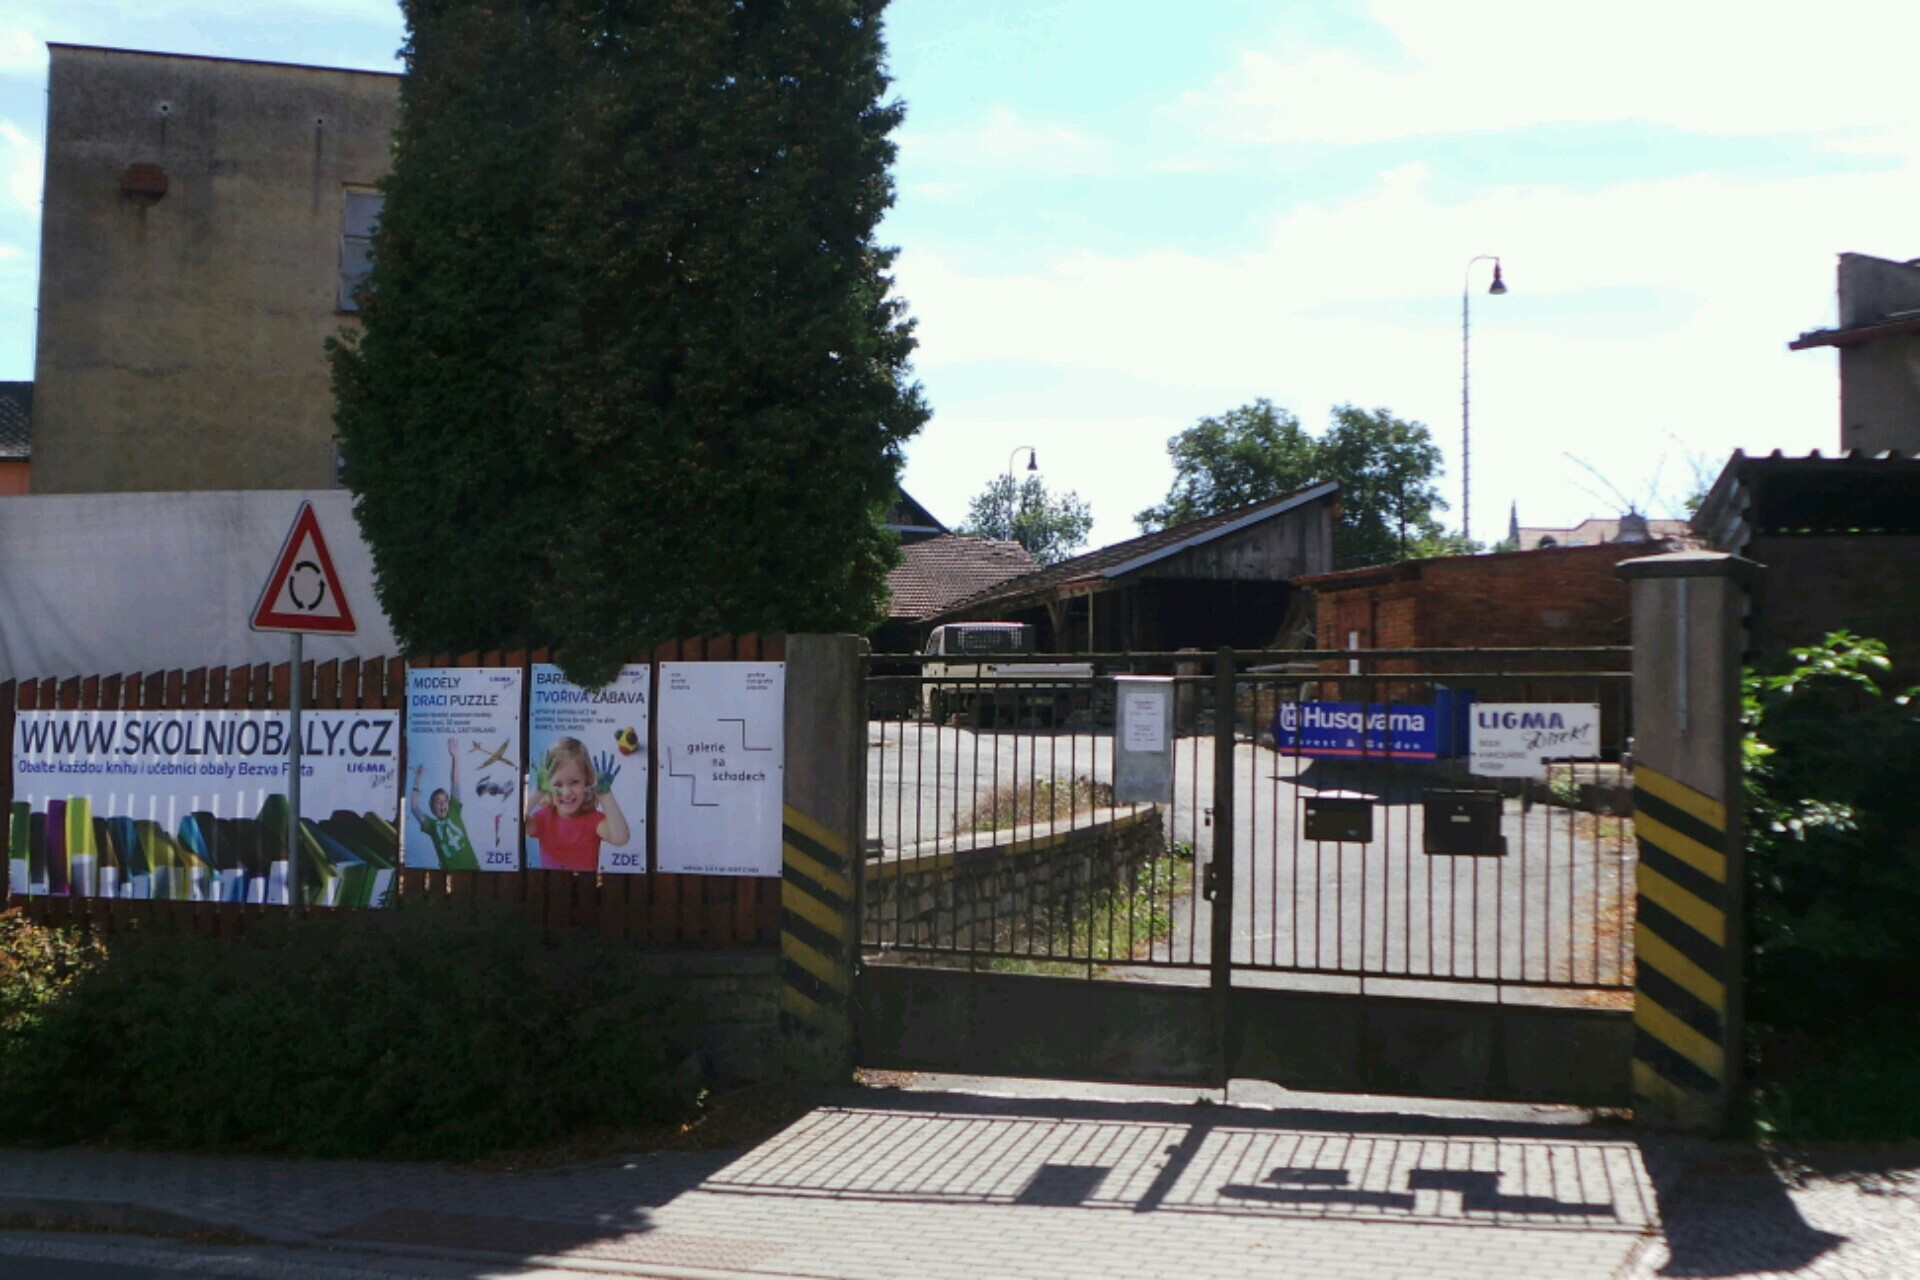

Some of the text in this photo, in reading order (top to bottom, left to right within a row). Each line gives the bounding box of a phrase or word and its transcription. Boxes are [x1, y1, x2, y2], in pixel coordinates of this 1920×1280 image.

[413, 676, 461, 689] MODELY
[412, 694, 499, 707] DRACI PUZZLE
[1304, 706, 1425, 733] Husqvarna
[1478, 711, 1565, 730] LIGMA
[20, 719, 394, 757] WWW.SKOLNIOBALY.CZ
[1346, 738, 1355, 748] &
[1365, 739, 1421, 751] Gaden
[687, 742, 726, 755] galerie
[347, 762, 386, 773] LIGMA
[712, 758, 726, 767] na
[106, 760, 138, 775] knihu
[200, 761, 235, 779] obaly
[238, 762, 279, 776] Bezva
[486, 852, 513, 865] ZDE
[611, 853, 640, 867] ZDE
